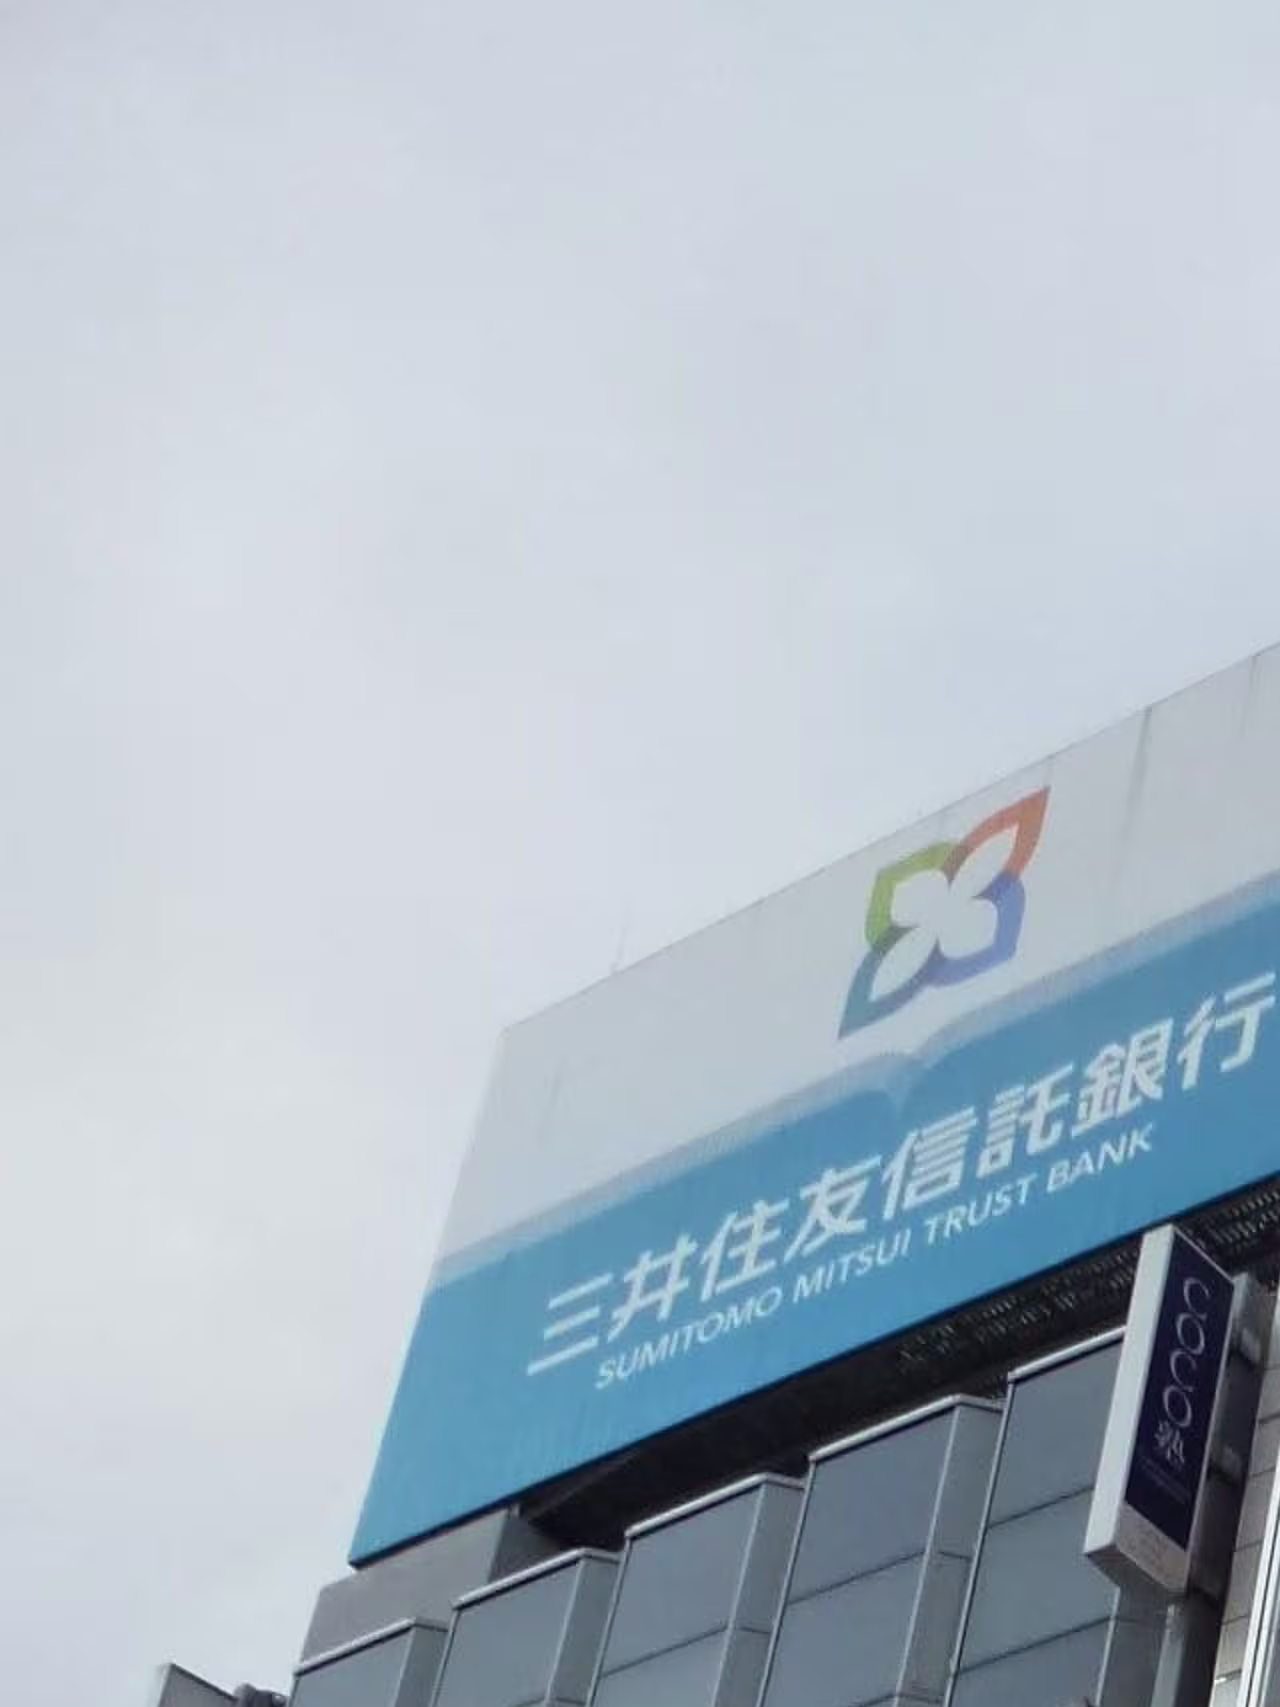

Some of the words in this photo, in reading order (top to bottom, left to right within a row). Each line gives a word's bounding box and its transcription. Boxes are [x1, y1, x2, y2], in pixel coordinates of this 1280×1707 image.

[526, 973, 1276, 1375] 三井住友信託銀行
[594, 1286, 782, 1391] SUMITOMO
[792, 1231, 911, 1303] MITSUI
[922, 1180, 1039, 1247] TRUST
[1046, 1124, 1153, 1191] BANK
